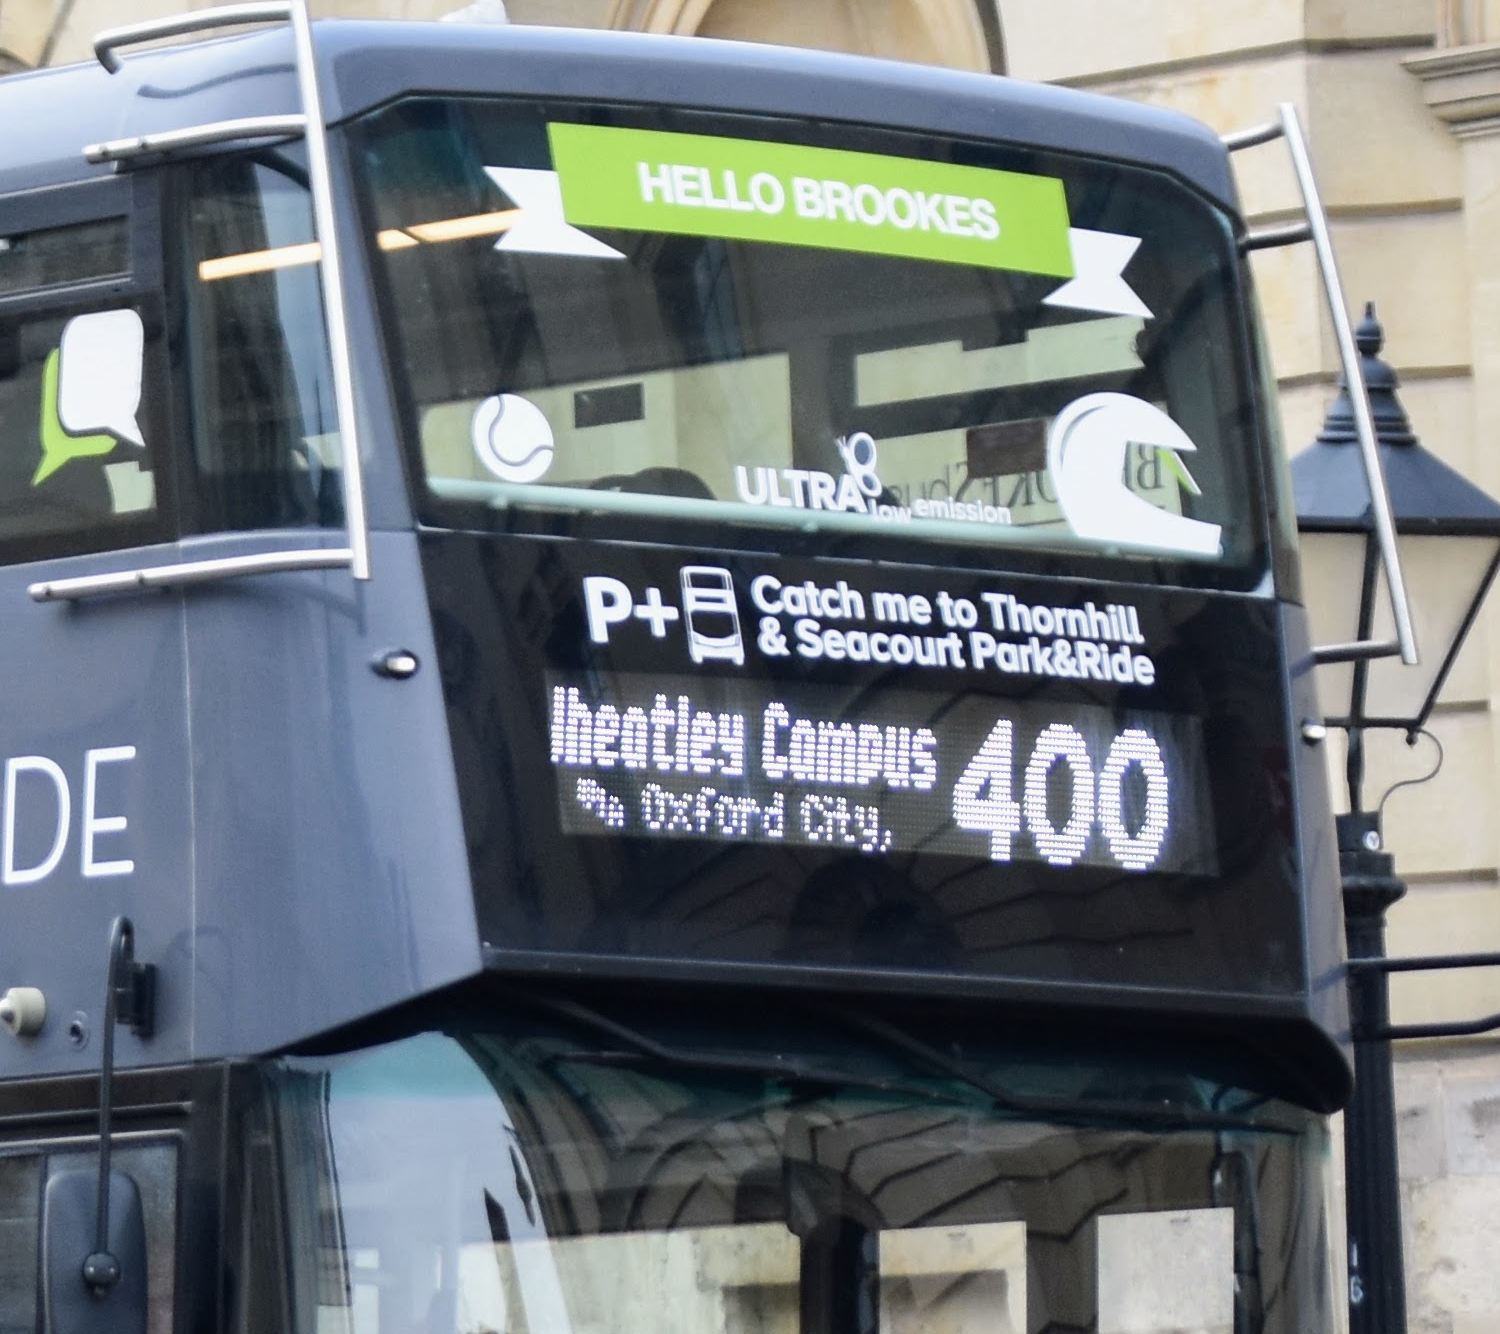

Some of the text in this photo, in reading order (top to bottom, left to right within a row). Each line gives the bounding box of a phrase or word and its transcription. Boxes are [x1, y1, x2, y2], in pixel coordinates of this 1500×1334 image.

[637, 162, 1001, 240] HELLO BROOKES
[736, 466, 867, 513] ULTRA
[868, 496, 1012, 525] low emission
[752, 575, 1145, 645] Catch me to Thornhill
[757, 616, 1156, 687] & Seacourt Park&Ride
[762, 701, 938, 790] Campus
[640, 781, 784, 838] Oxford
[952, 718, 1170, 870] 400
